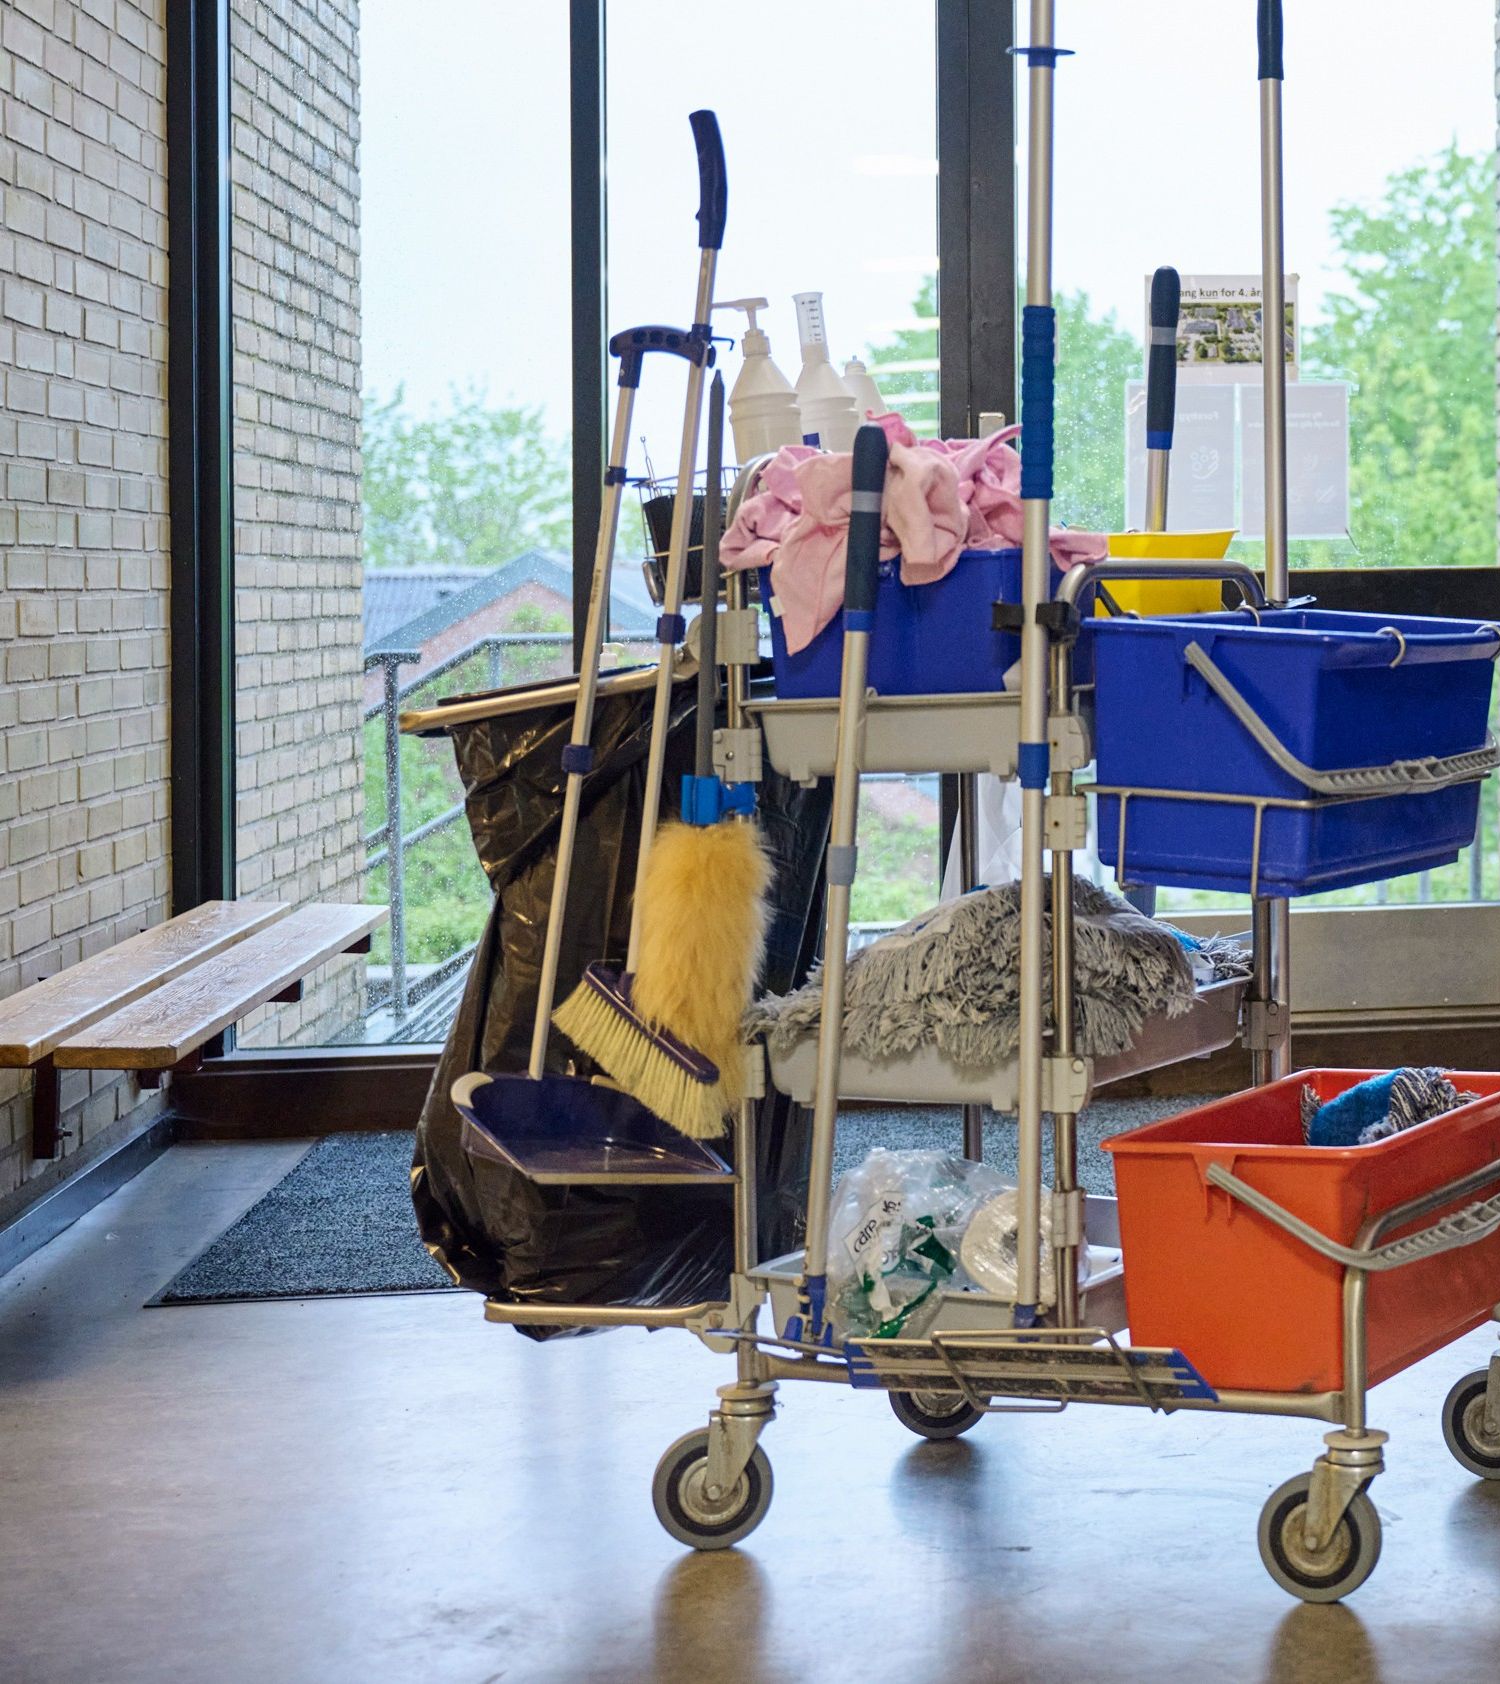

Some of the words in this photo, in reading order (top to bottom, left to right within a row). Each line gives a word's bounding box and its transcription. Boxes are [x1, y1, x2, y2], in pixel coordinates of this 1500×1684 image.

[1179, 289, 1197, 298] ang
[1199, 287, 1218, 298] kun
[1221, 287, 1236, 297] for
[1238, 288, 1248, 297] 4.
[1250, 287, 1264, 298] år
